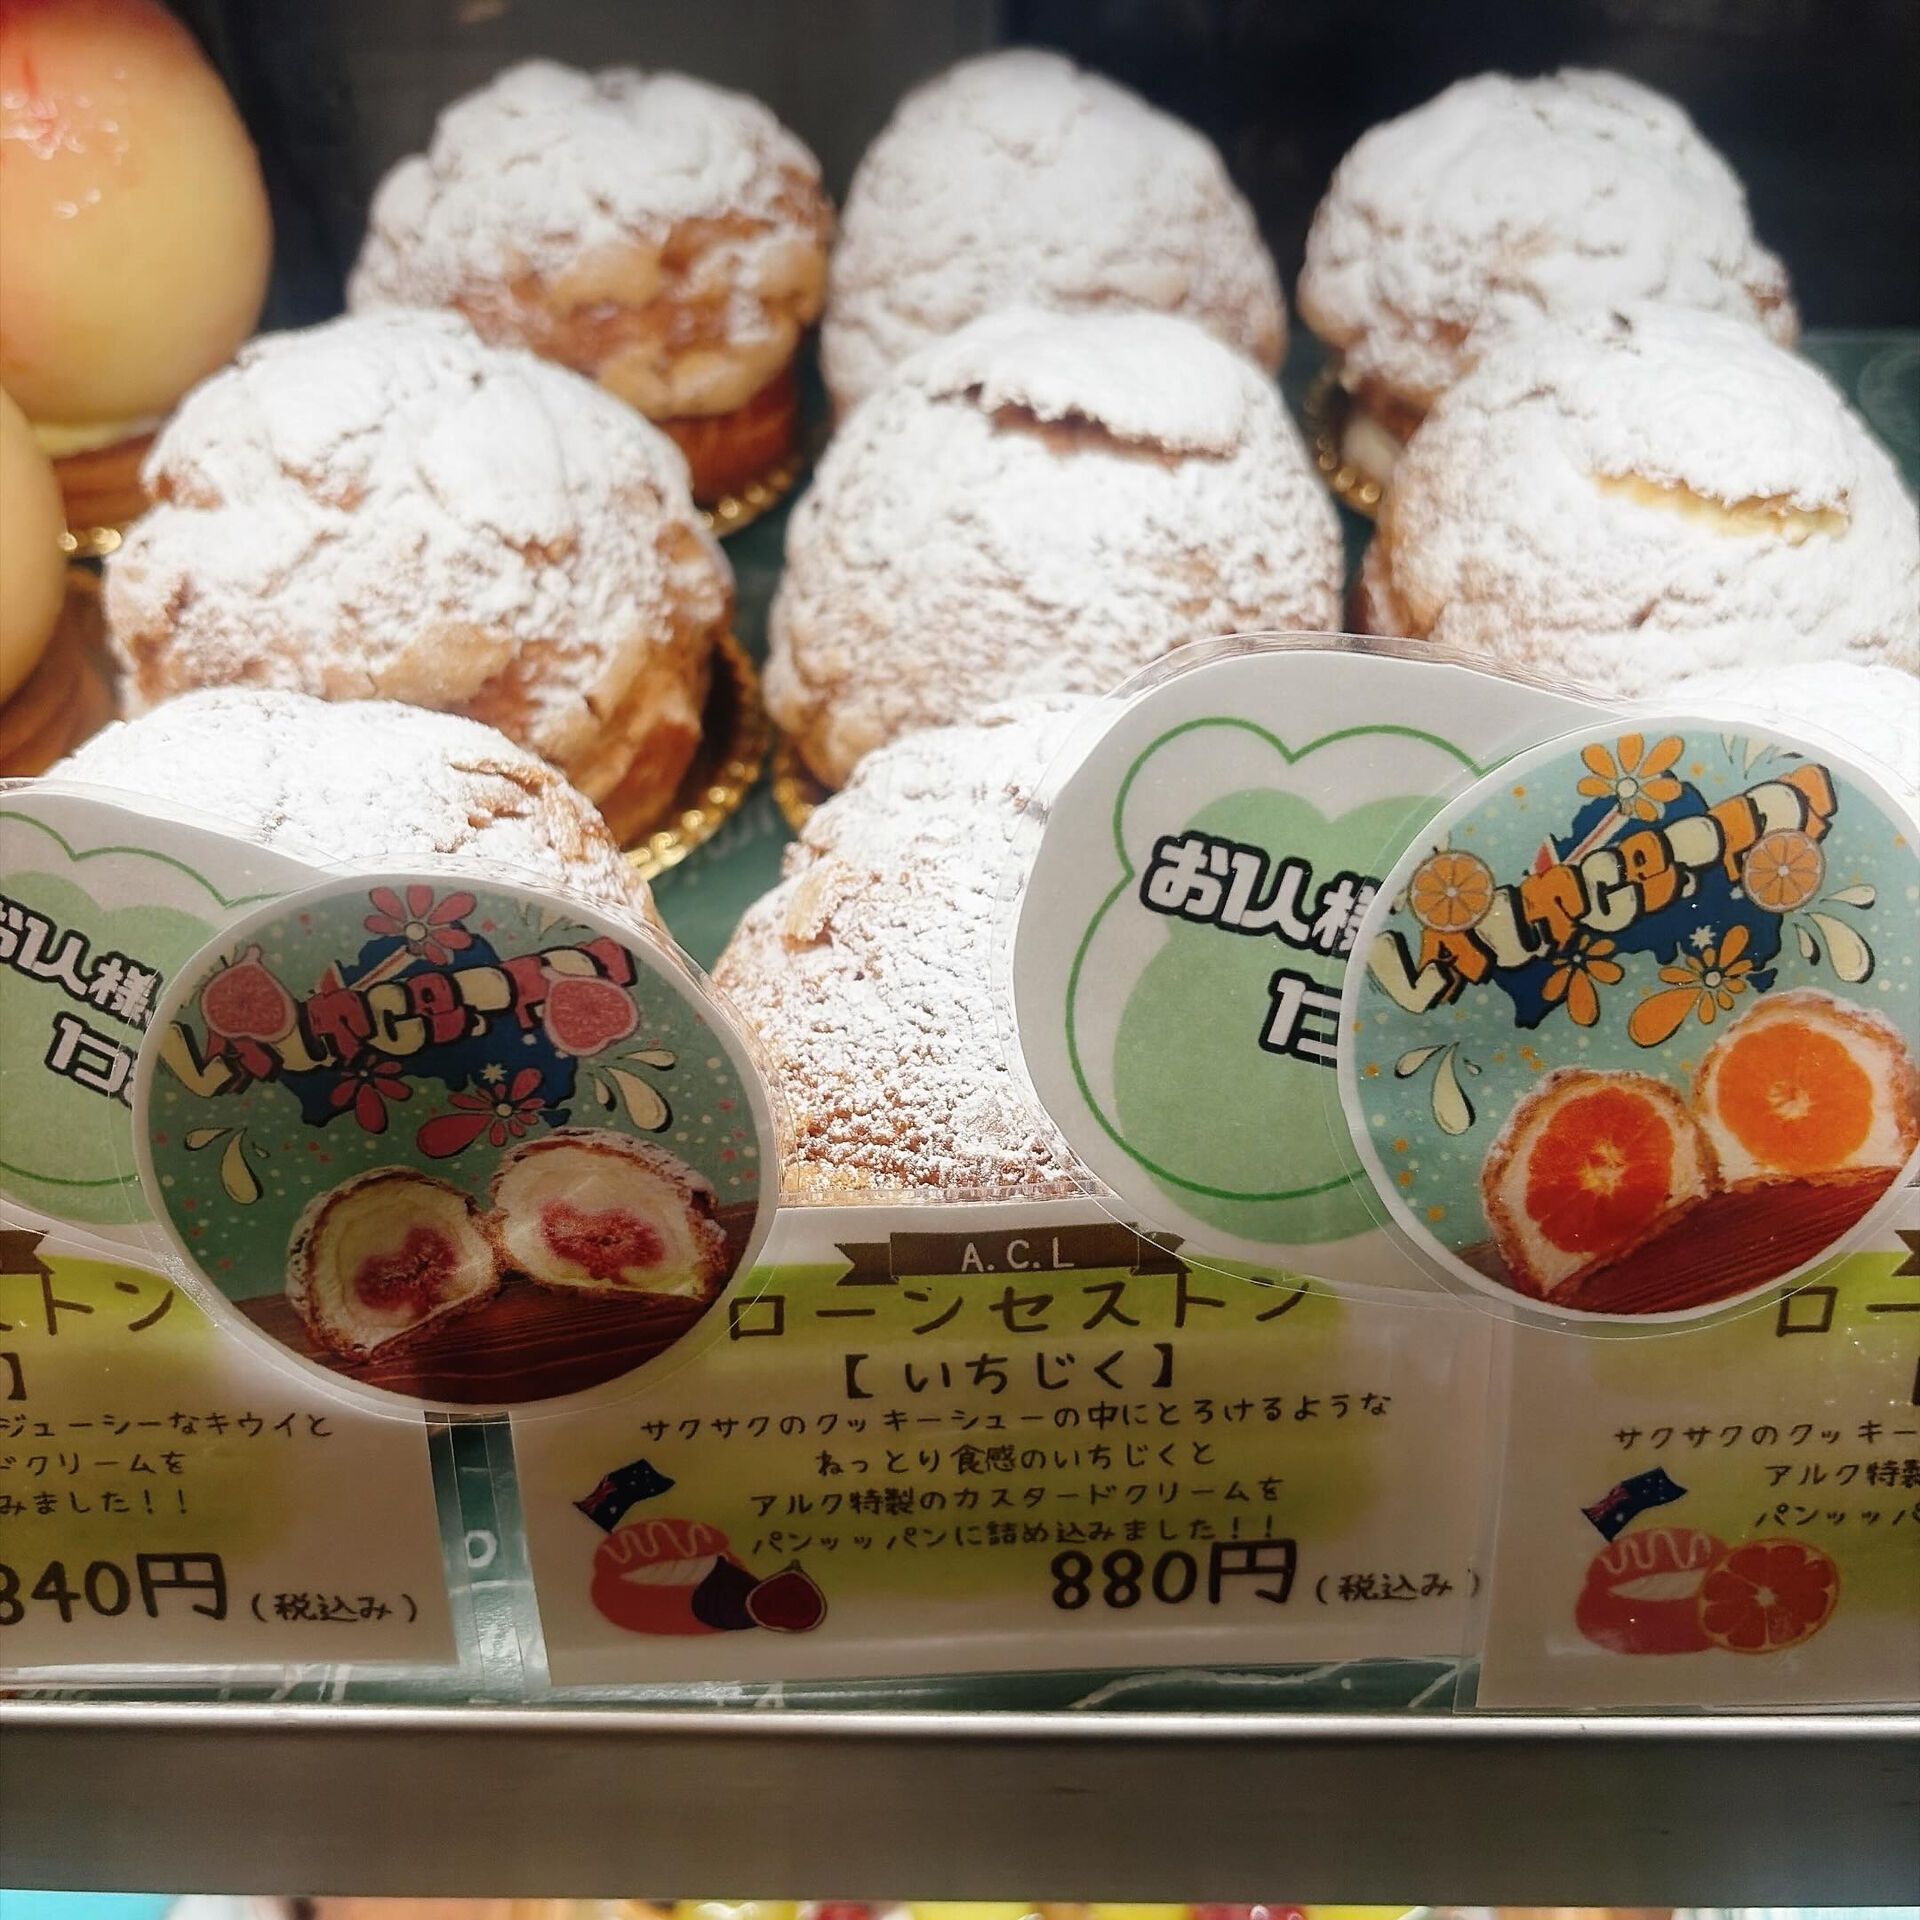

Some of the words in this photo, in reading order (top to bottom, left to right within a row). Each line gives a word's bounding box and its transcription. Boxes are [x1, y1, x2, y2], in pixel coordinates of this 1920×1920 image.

[0, 1272, 174, 1336] トン
[729, 1272, 1310, 1341] ローンセストン
[641, 1394, 1392, 1443] サクサクのクッキーシューの中にとろけるような
[816, 1441, 1216, 1477] ねっとり食感のいちじくと
[750, 1476, 1284, 1516] アルク特製のカスタードクリームを
[1050, 1538, 1297, 1610] 880円
